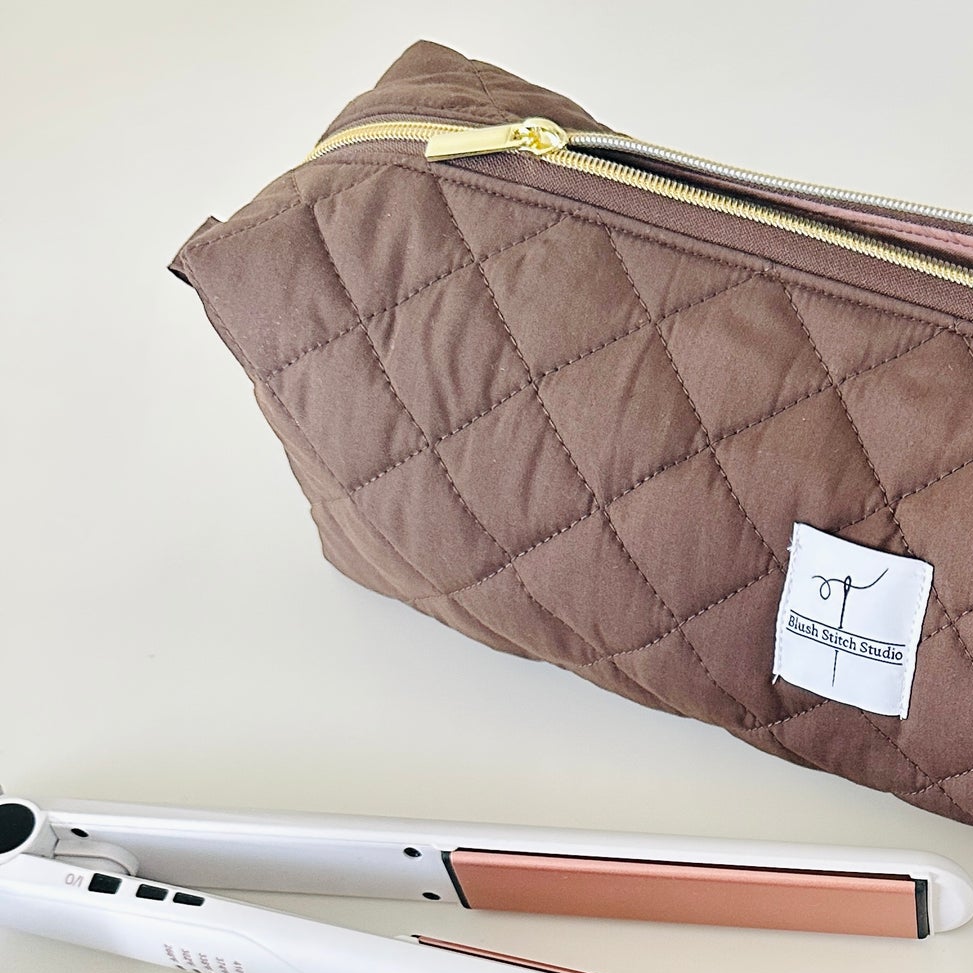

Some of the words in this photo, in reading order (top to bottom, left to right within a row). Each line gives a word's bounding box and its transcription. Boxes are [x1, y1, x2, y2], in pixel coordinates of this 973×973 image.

[787, 614, 819, 638] Blush
[821, 629, 857, 652] Stitch
[859, 641, 903, 661] Studio
